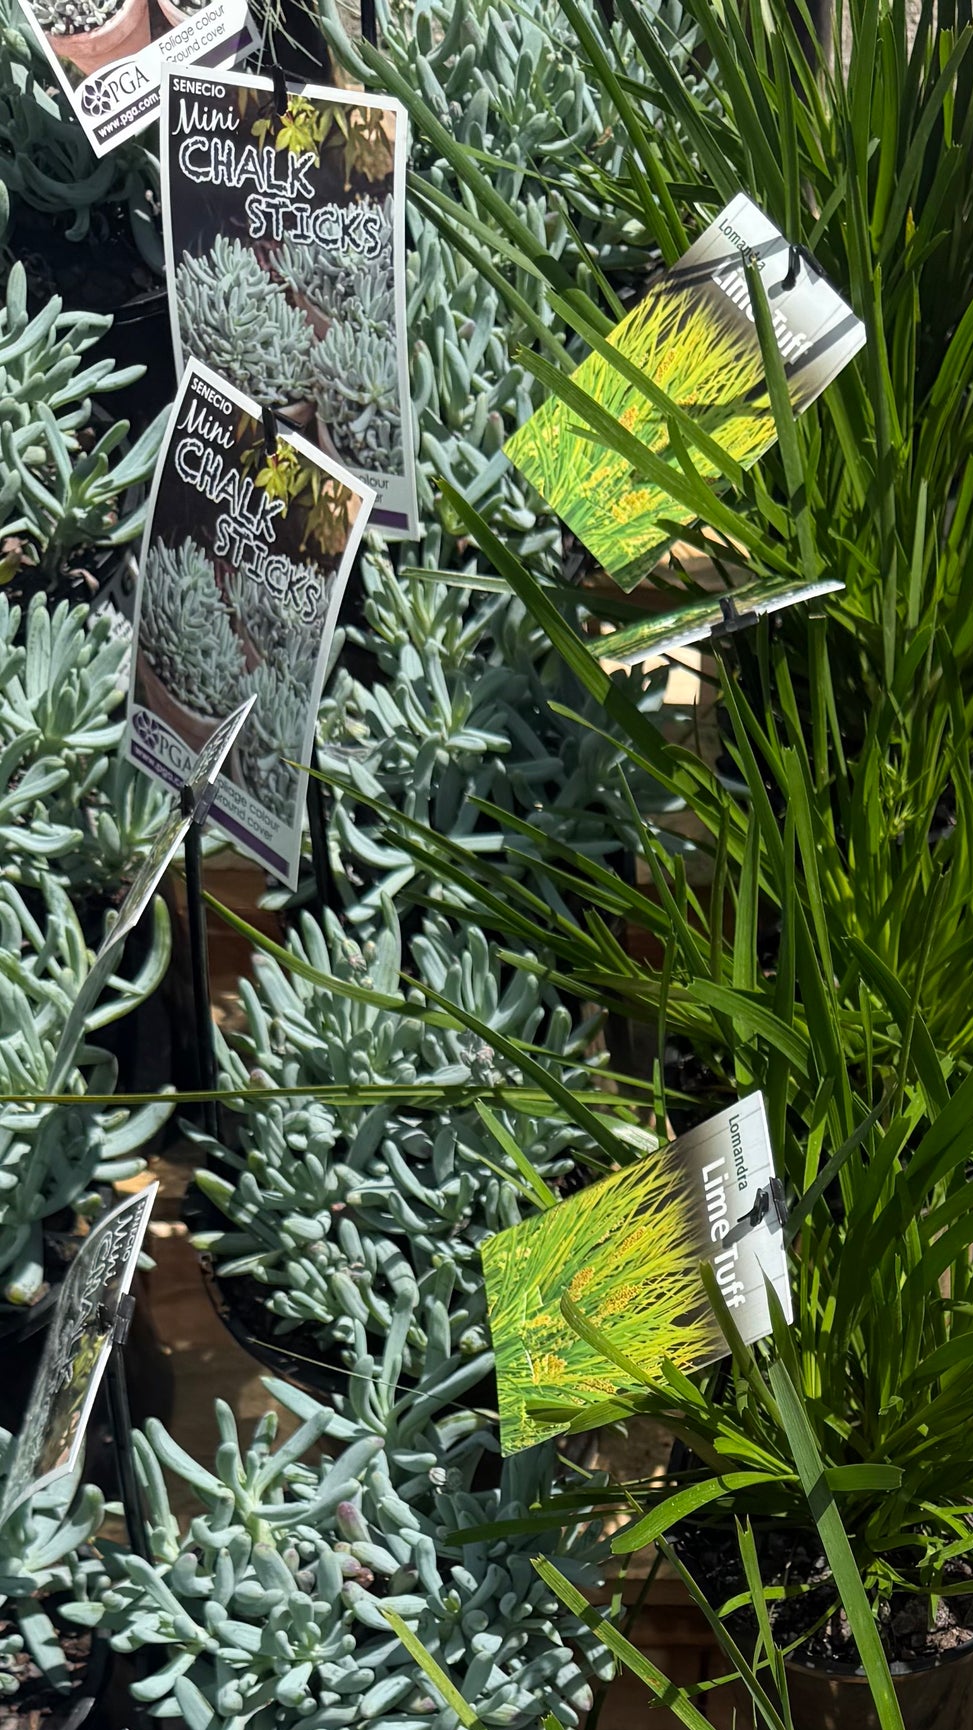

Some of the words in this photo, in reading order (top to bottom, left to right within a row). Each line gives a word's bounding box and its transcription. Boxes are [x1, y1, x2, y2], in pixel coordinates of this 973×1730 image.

[158, 25, 194, 54] Foliage
[195, 4, 226, 32] colour
[200, 23, 226, 46] cover
[109, 66, 150, 103] PGA
[172, 78, 226, 99] SENECIO
[172, 98, 240, 136] Mini
[179, 135, 315, 199] CHALK
[245, 192, 383, 260] STICKS
[190, 377, 233, 415] SENECIO
[177, 399, 235, 449] Mini
[175, 437, 285, 543] CHALK
[214, 513, 322, 623] STICKS
[160, 734, 192, 772] PGA
[216, 795, 246, 820] round
[217, 779, 247, 807] oliage
[249, 804, 280, 832] colour
[728, 1114, 748, 1191] Lomandra
[702, 1156, 731, 1243] Lime
[714, 1241, 746, 1309] Tuff
